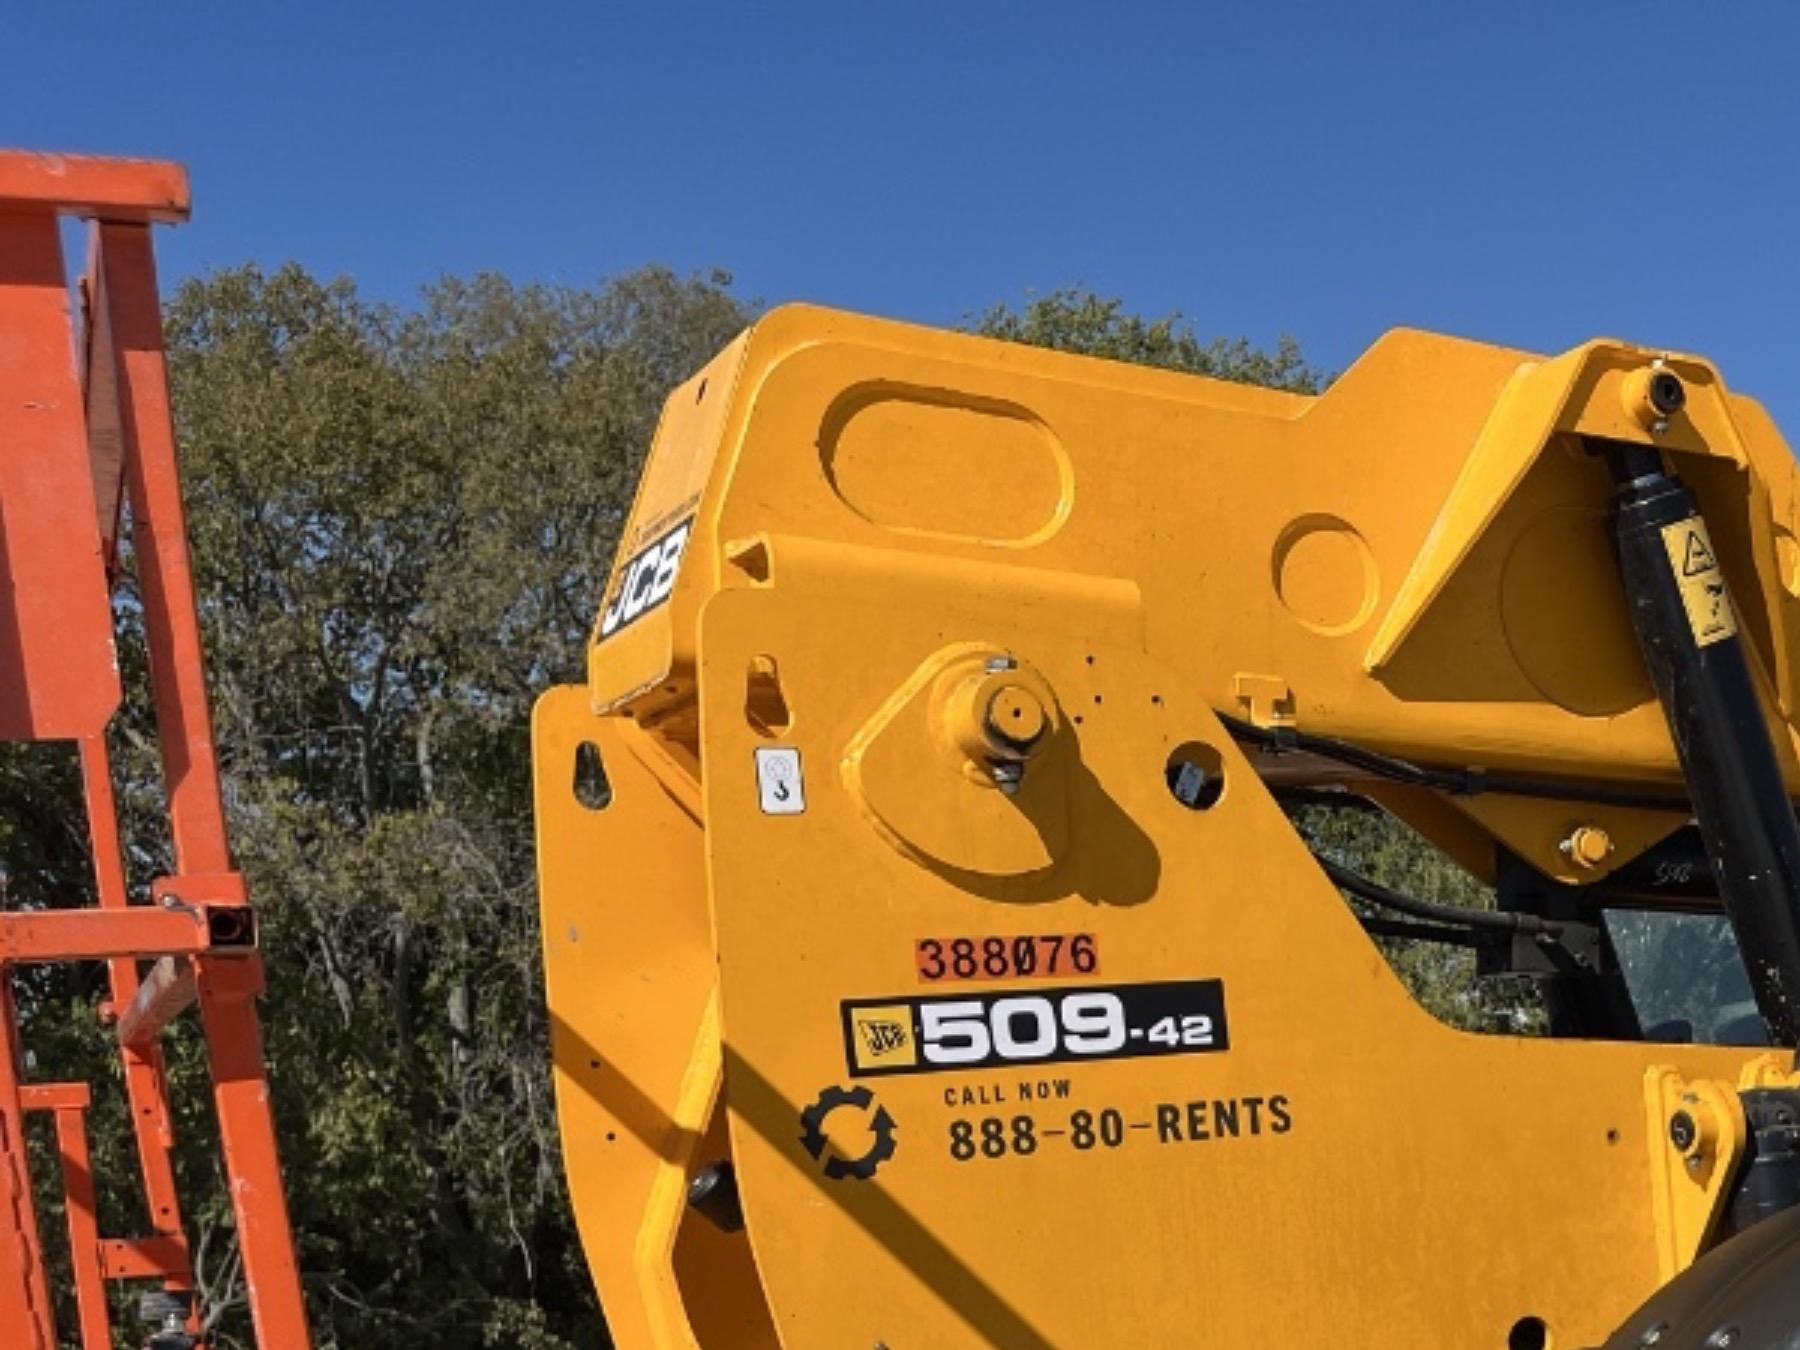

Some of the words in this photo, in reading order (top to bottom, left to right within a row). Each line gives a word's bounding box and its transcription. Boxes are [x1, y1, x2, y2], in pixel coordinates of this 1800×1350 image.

[601, 522, 690, 636] JCB
[918, 932, 1097, 981] 388076
[920, 993, 1213, 1064] 509-42
[944, 1085, 1006, 1106] CALL
[1018, 1080, 1072, 1101] NOW
[949, 1094, 1293, 1161] 888-80-RENTS
